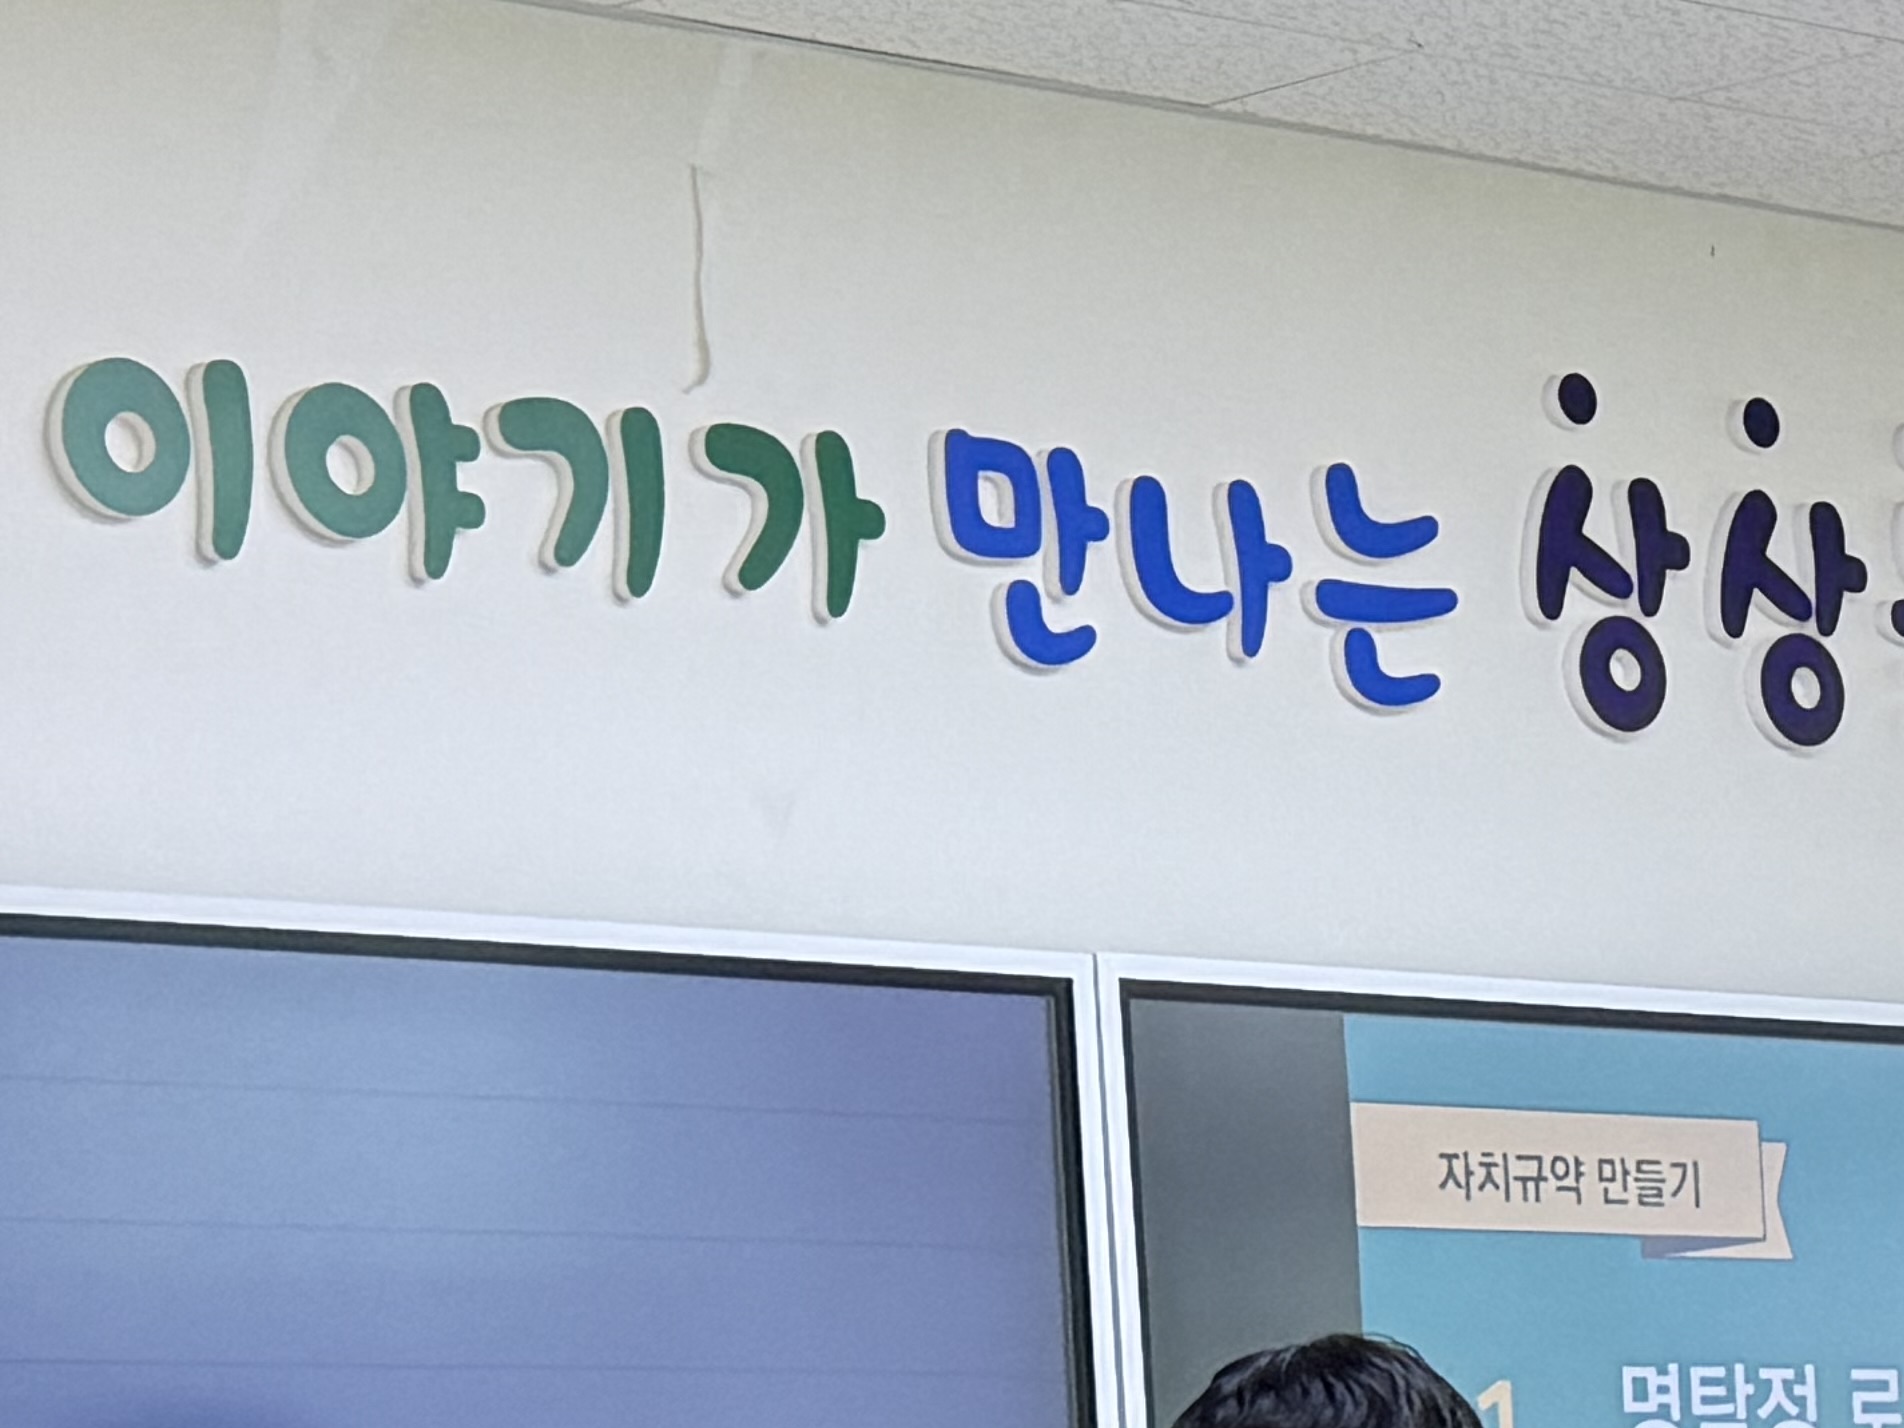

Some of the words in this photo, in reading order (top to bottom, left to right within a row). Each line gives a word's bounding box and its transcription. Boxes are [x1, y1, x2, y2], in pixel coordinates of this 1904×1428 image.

[48, 355, 888, 622] 이야기가
[938, 427, 1460, 712] 만나는
[1437, 1149, 1586, 1206] 자치규약
[1597, 1156, 1703, 1209] 만들기
